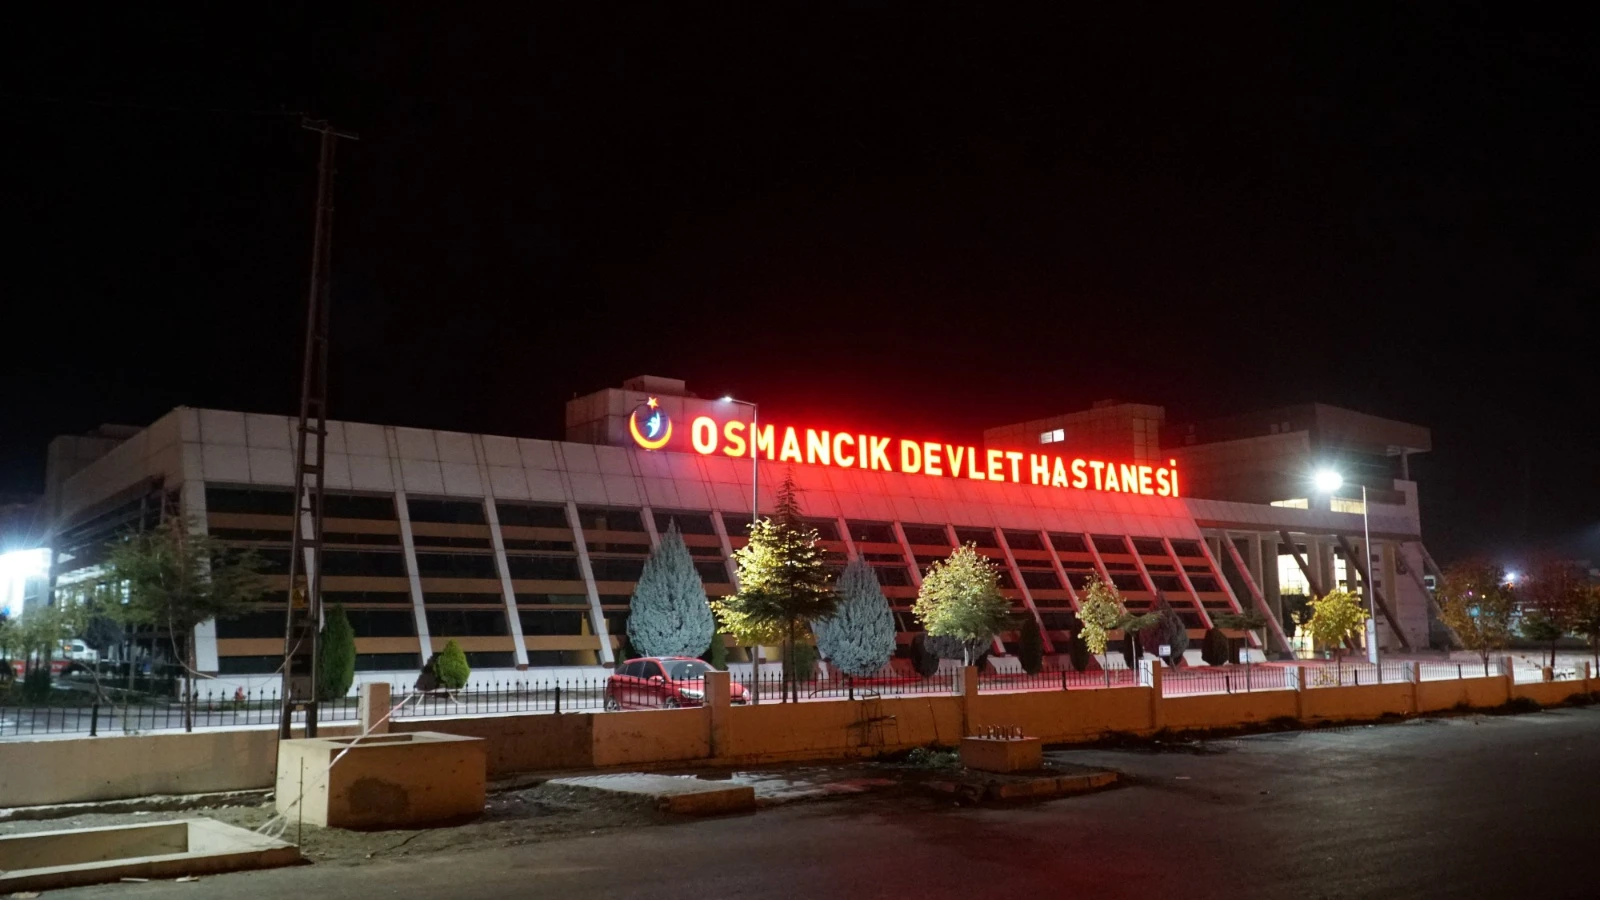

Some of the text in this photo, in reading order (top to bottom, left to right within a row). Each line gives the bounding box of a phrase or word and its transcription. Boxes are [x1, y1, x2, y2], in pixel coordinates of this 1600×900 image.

[691, 416, 1179, 498] OSMANCIK DEVLET HASTANESİ
